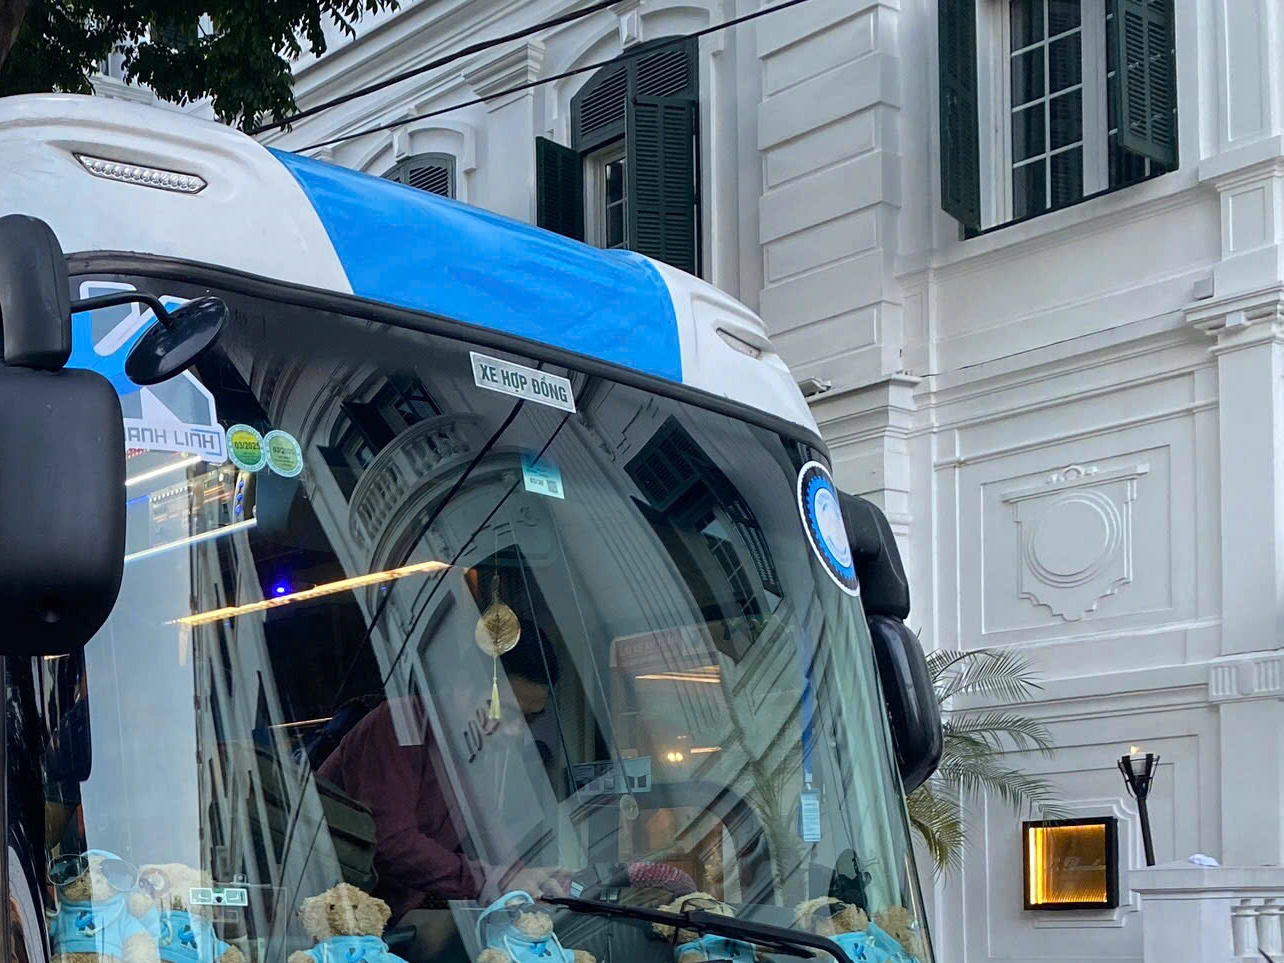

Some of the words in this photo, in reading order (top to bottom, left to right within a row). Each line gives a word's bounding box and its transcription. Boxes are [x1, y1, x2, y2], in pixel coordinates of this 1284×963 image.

[480, 364, 498, 383] XE
[501, 369, 527, 392] HỢP
[125, 426, 166, 444] ANH
[174, 430, 215, 449] LINH
